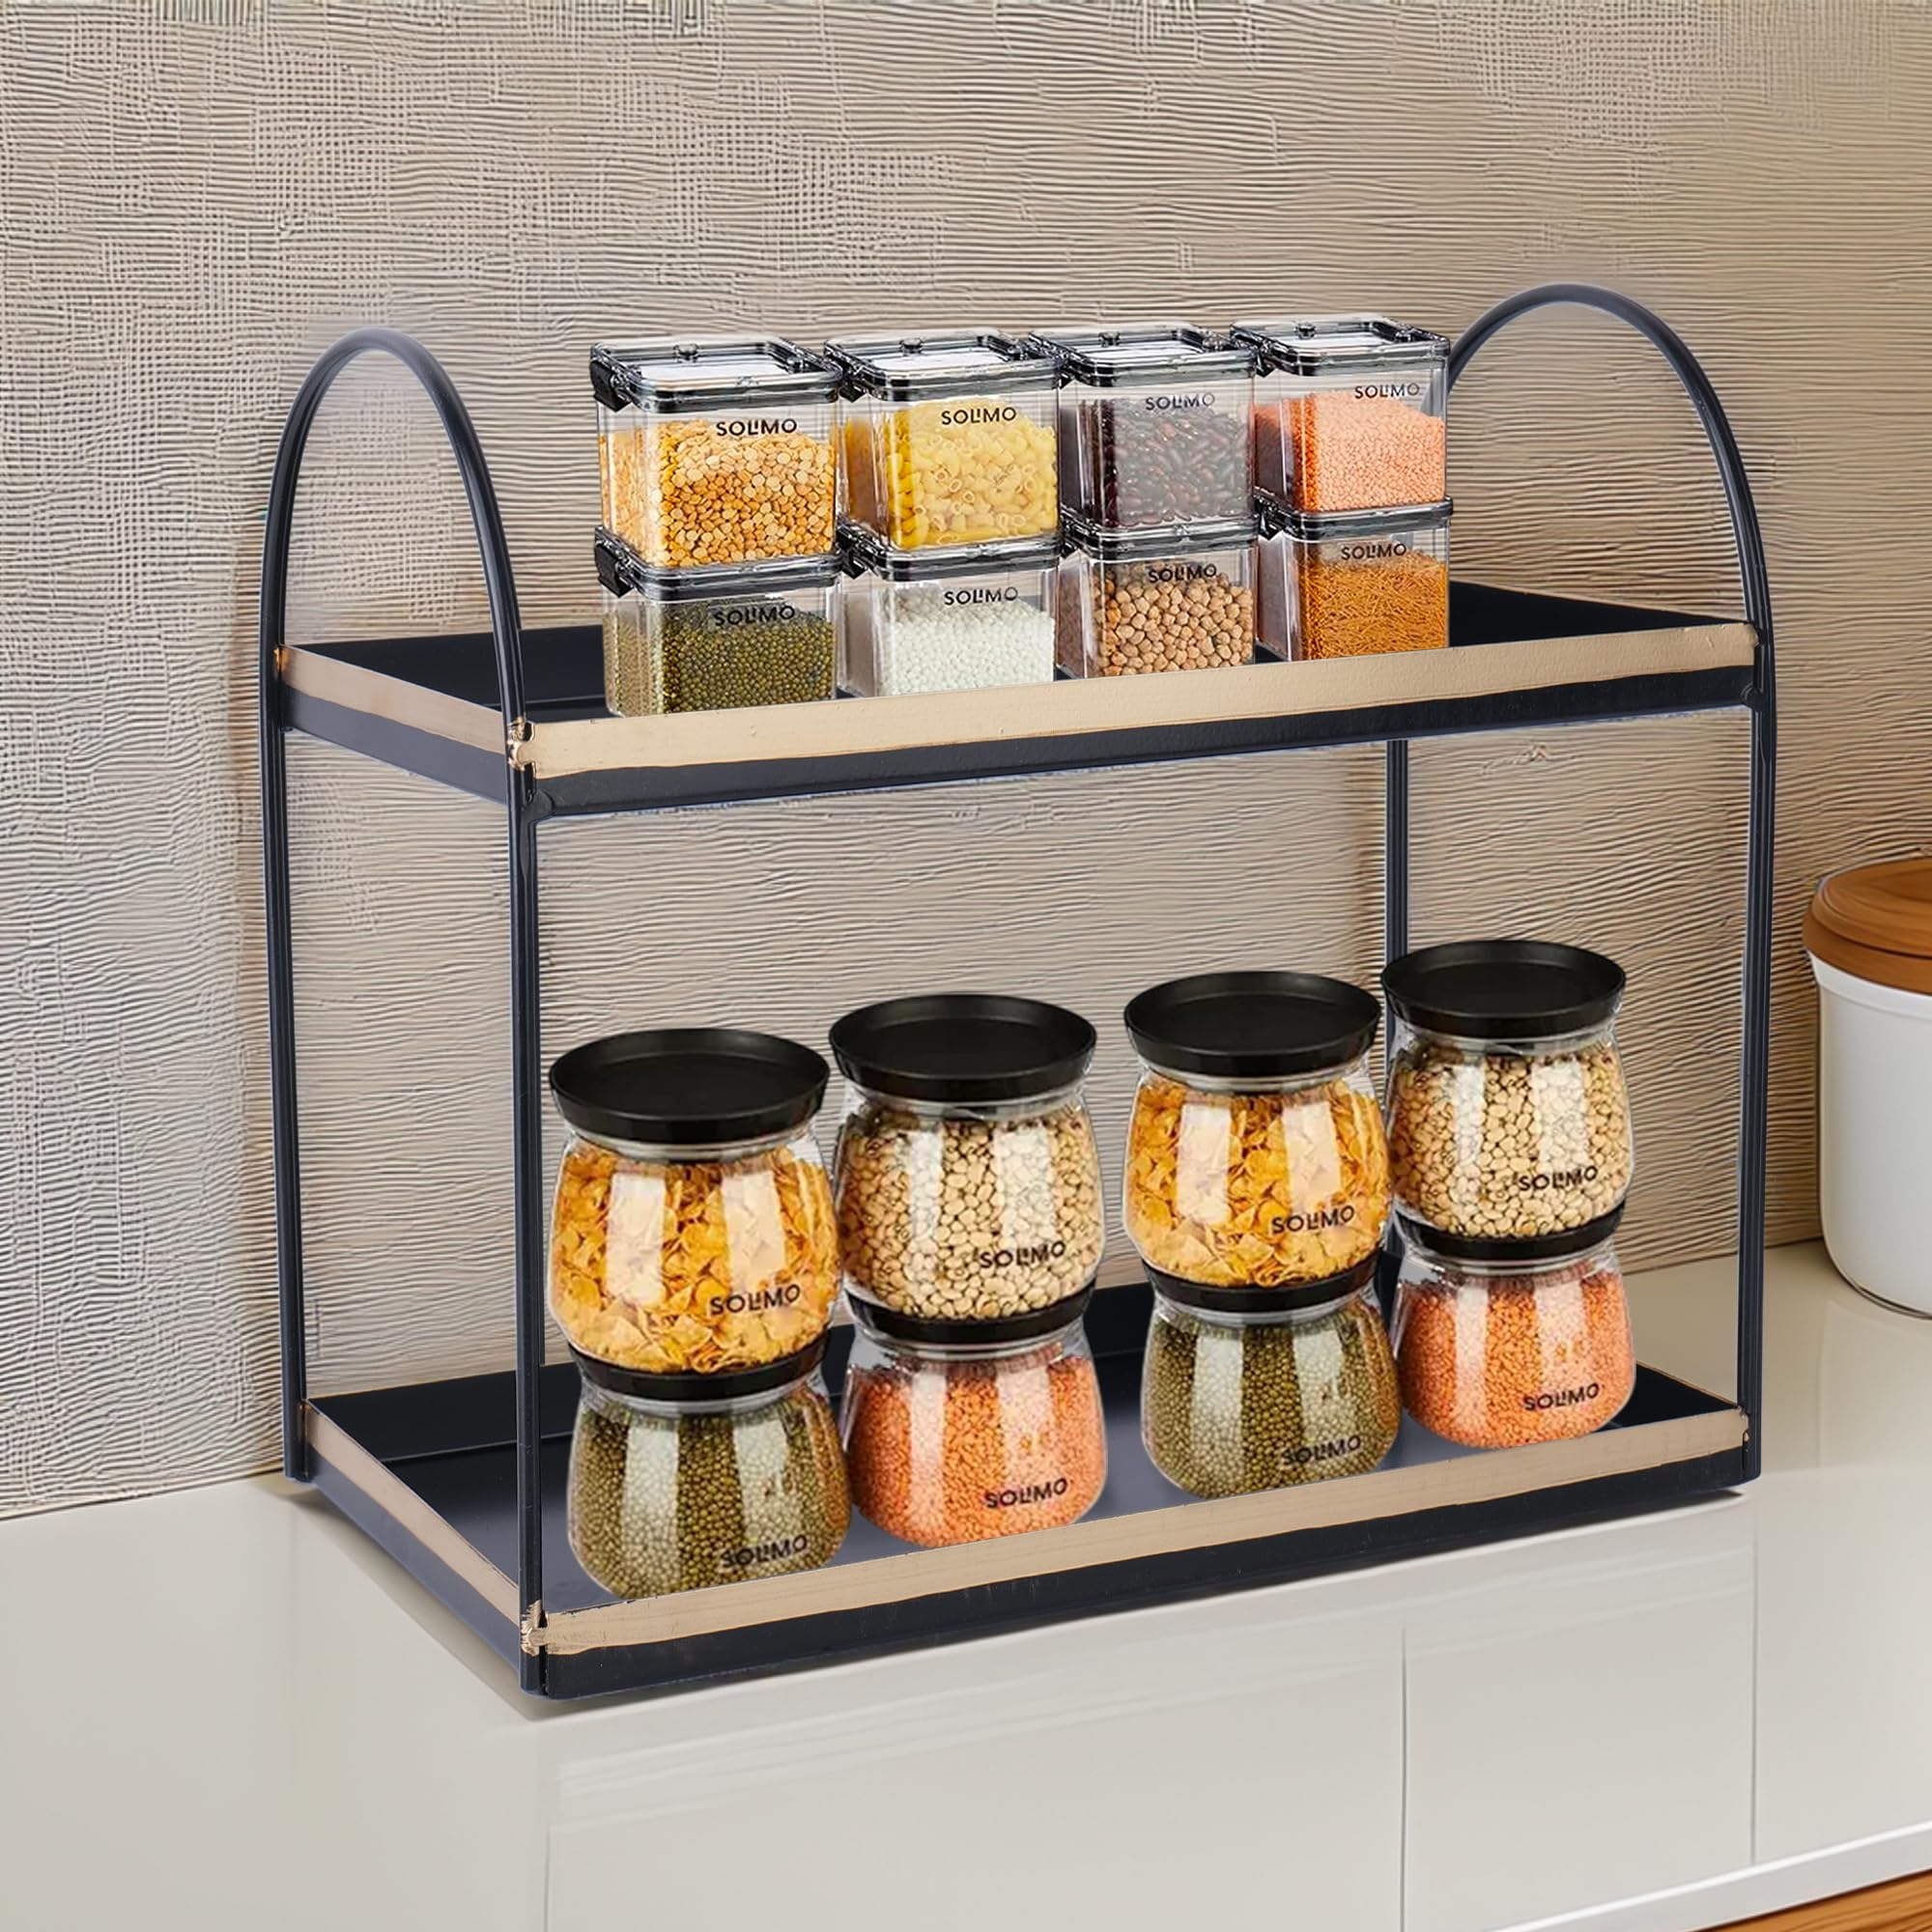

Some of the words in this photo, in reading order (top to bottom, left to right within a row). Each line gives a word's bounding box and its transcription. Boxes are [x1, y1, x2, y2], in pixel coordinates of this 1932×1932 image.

[1145, 392, 1215, 412] SOLIMO
[1354, 383, 1420, 401] SOLIMO
[716, 418, 798, 438] SOLIMO
[941, 407, 1016, 426] SOLIMO
[1341, 542, 1406, 561] SOLIMO
[1149, 564, 1217, 583] SOLIMO
[944, 586, 1019, 606] SOLIMO
[714, 605, 796, 628] SOLIMO
[1518, 1165, 1599, 1191] SOLIMO
[1271, 1205, 1356, 1236] SOLIMO
[979, 1239, 1066, 1269] SOLIMO
[709, 1283, 802, 1316] SOLIMO
[1521, 1382, 1601, 1411] SOLIMO
[1281, 1436, 1362, 1465] SOLIMO
[983, 1477, 1069, 1509] SOLIMO
[720, 1534, 809, 1569] SOLIMO
